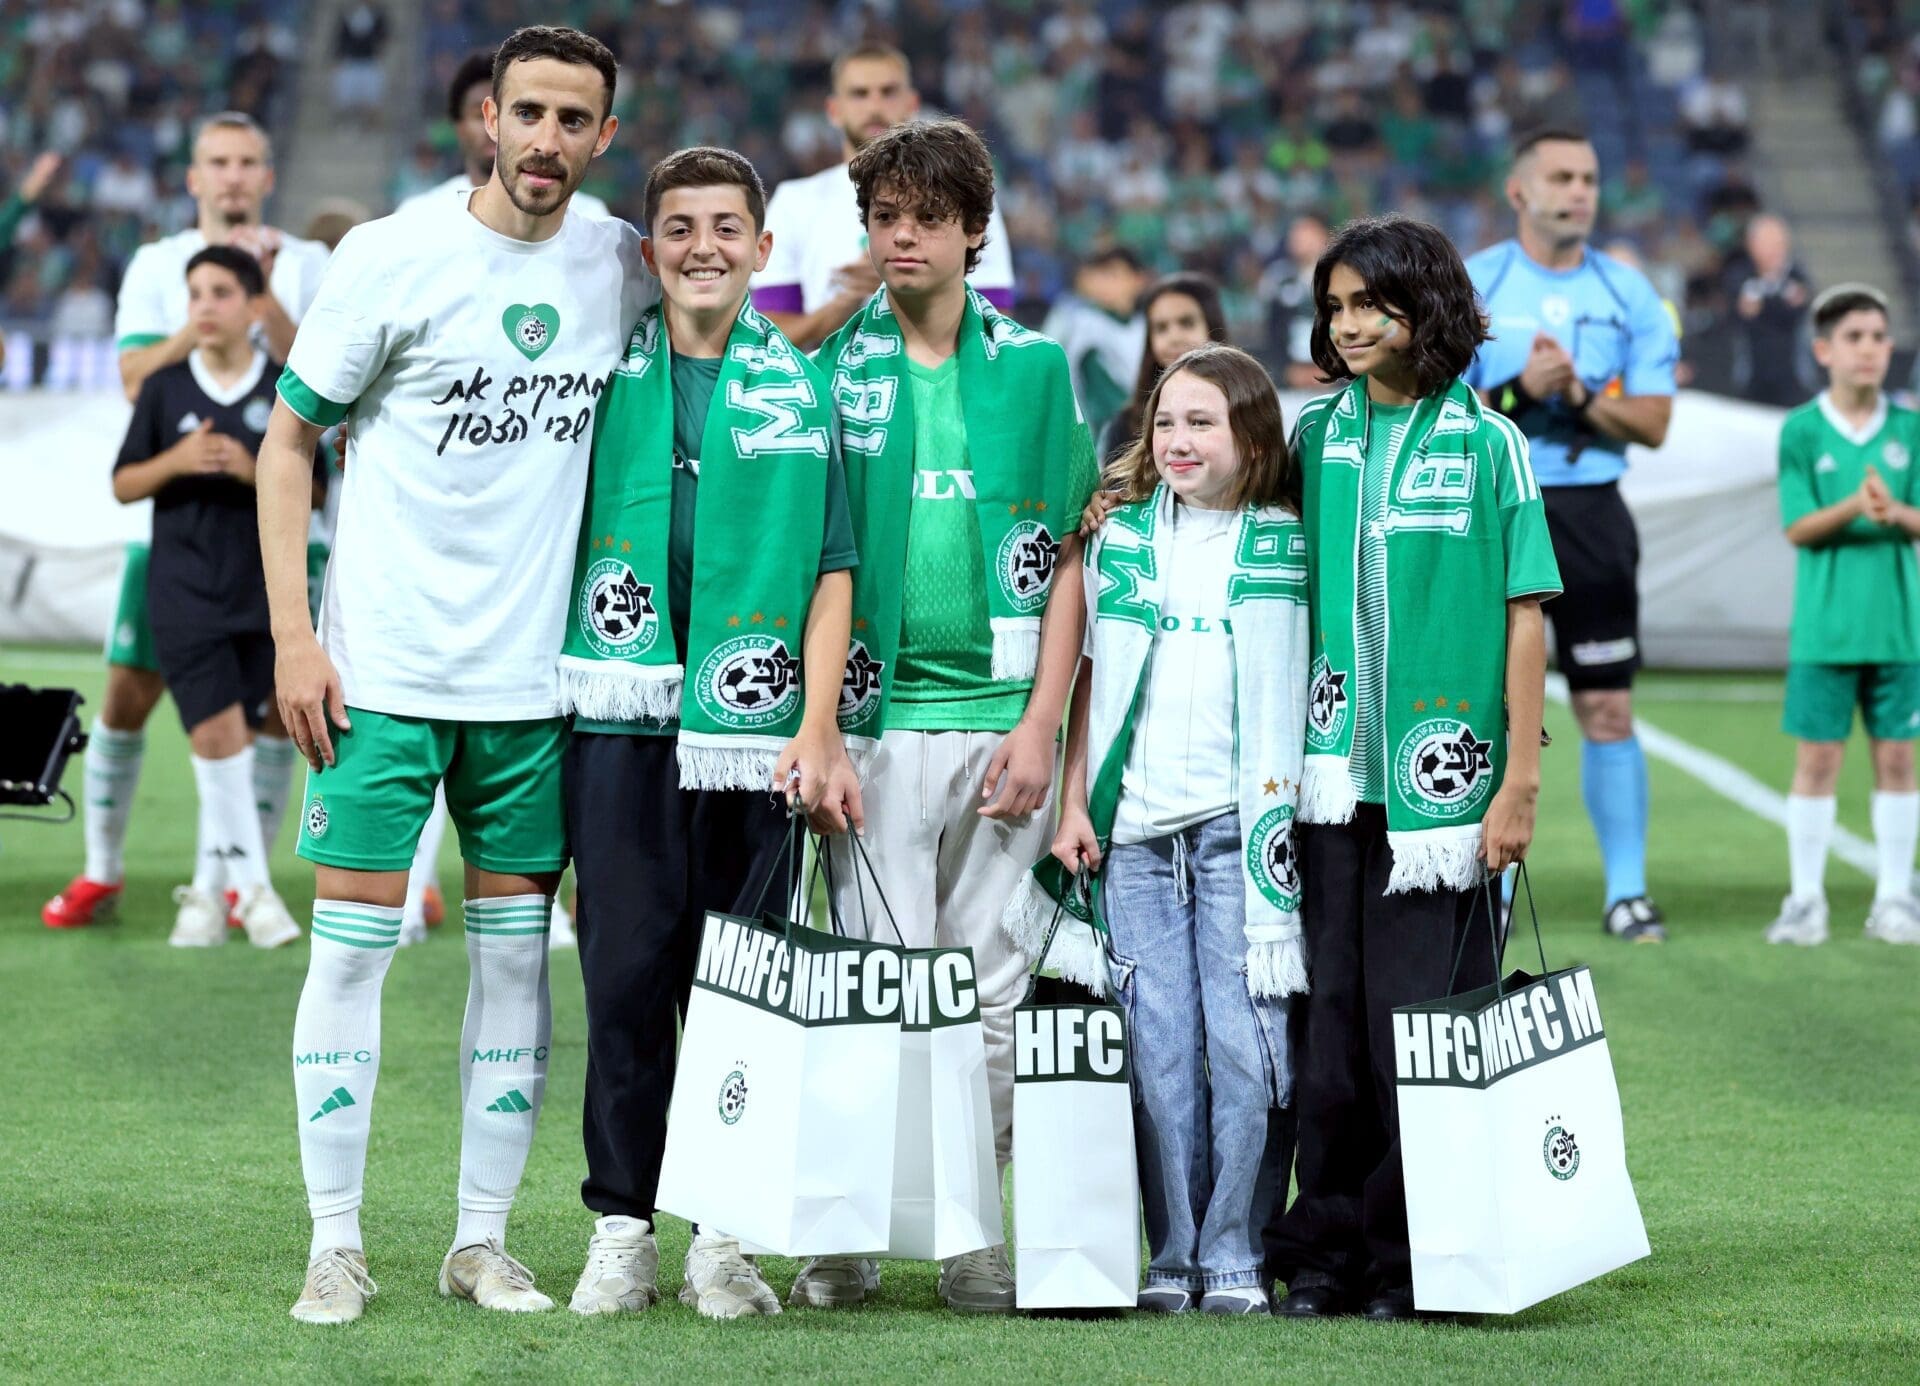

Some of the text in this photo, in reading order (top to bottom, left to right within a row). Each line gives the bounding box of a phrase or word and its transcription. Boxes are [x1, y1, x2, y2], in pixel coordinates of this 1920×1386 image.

[431, 366, 492, 405] את
[471, 1046, 548, 1063] MHFC
[1015, 1009, 1124, 1076] HFC
[296, 1050, 371, 1067] MHFC
